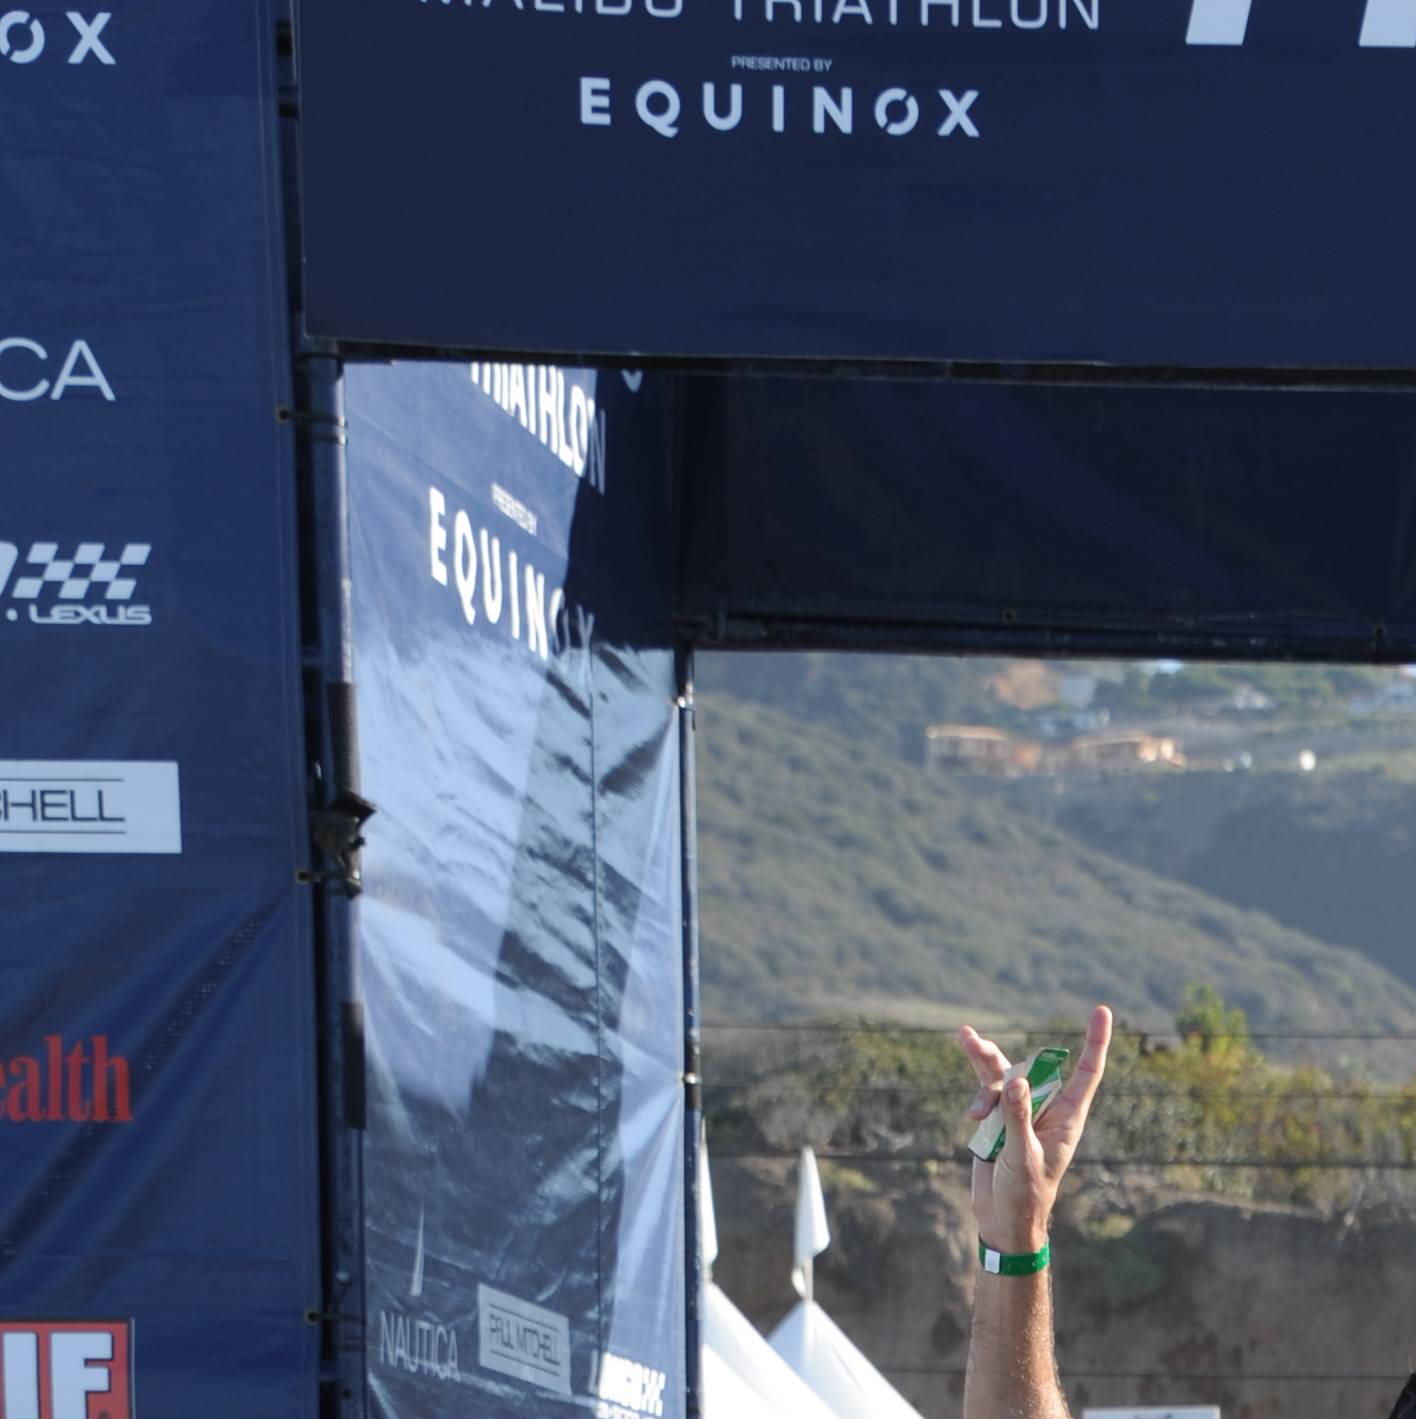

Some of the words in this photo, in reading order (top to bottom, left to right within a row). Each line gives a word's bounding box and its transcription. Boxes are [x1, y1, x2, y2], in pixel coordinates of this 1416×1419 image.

[731, 55, 811, 71] PRESENTED
[813, 58, 832, 72] BY
[580, 77, 980, 138] EQUINOX
[29, 603, 152, 625] LEXUS
[0, 789, 125, 822] HELL
[0, 1034, 133, 1123] alth
[378, 1309, 461, 1383] NAUTICA
